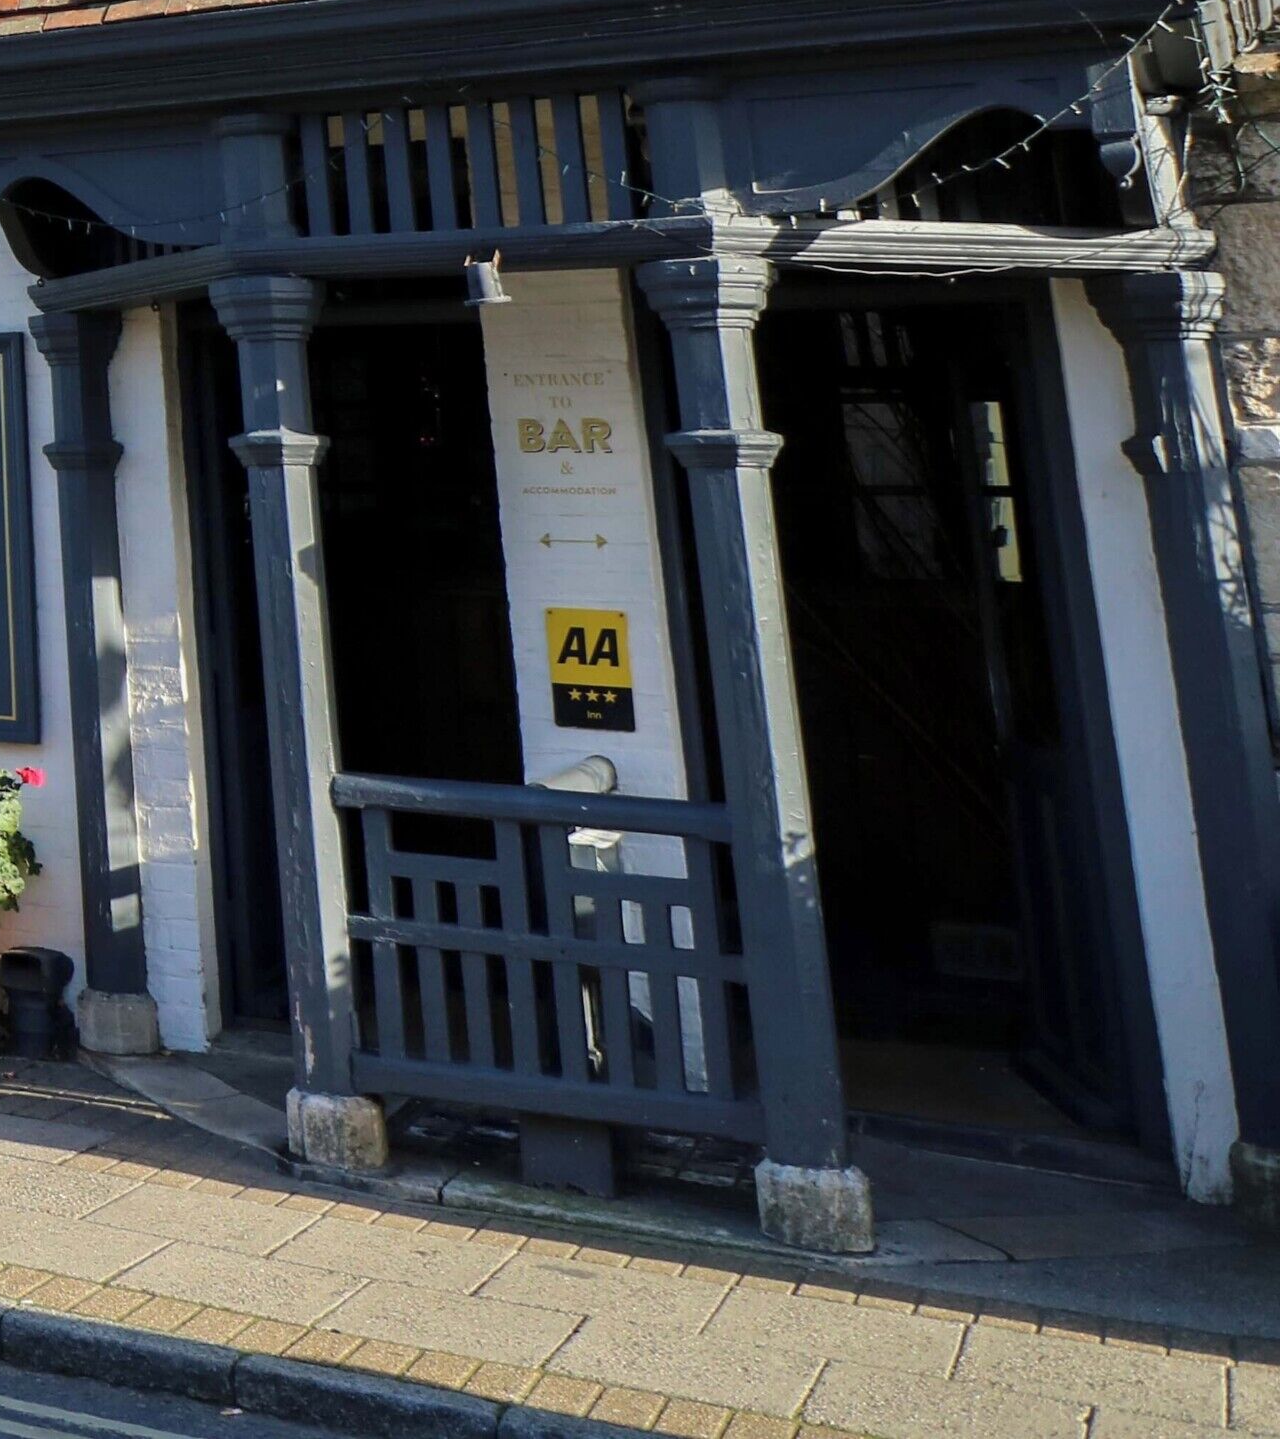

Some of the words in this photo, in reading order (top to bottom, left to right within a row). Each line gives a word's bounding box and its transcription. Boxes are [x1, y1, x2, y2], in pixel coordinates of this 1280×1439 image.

[512, 372, 605, 388] ENTRANCE
[548, 396, 572, 409] TO
[517, 417, 613, 453] BAR
[560, 460, 574, 475] &
[522, 486, 617, 495] ACCOMMODATION
[557, 626, 619, 667] AA
[586, 710, 602, 720] Inn
